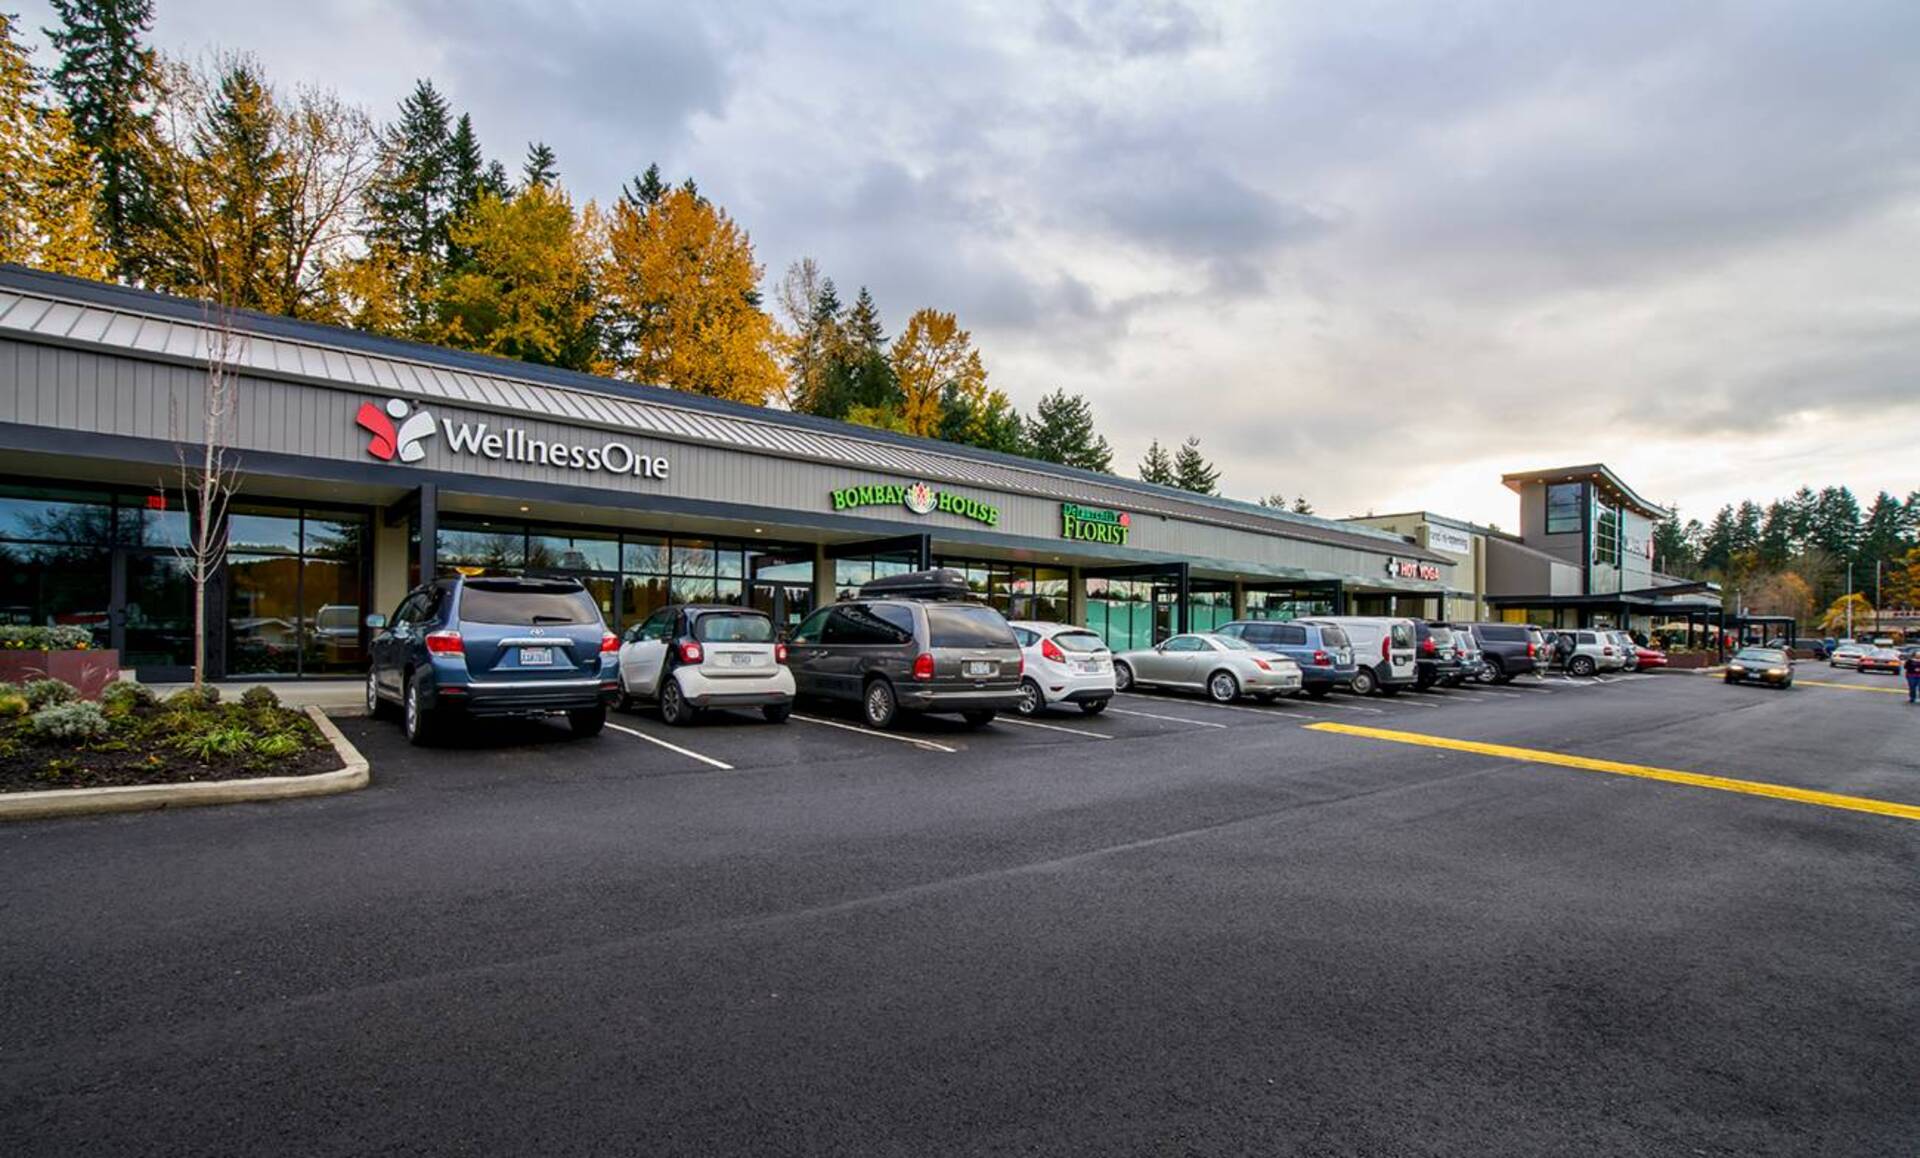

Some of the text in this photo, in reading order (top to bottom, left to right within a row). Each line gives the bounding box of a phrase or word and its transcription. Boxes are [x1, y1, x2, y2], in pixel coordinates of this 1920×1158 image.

[441, 418, 669, 479] WellnessOne
[833, 485, 1000, 526] BOMBAY HOUSE
[1063, 514, 1129, 545] FLORIST
[1401, 561, 1417, 577] HOT
